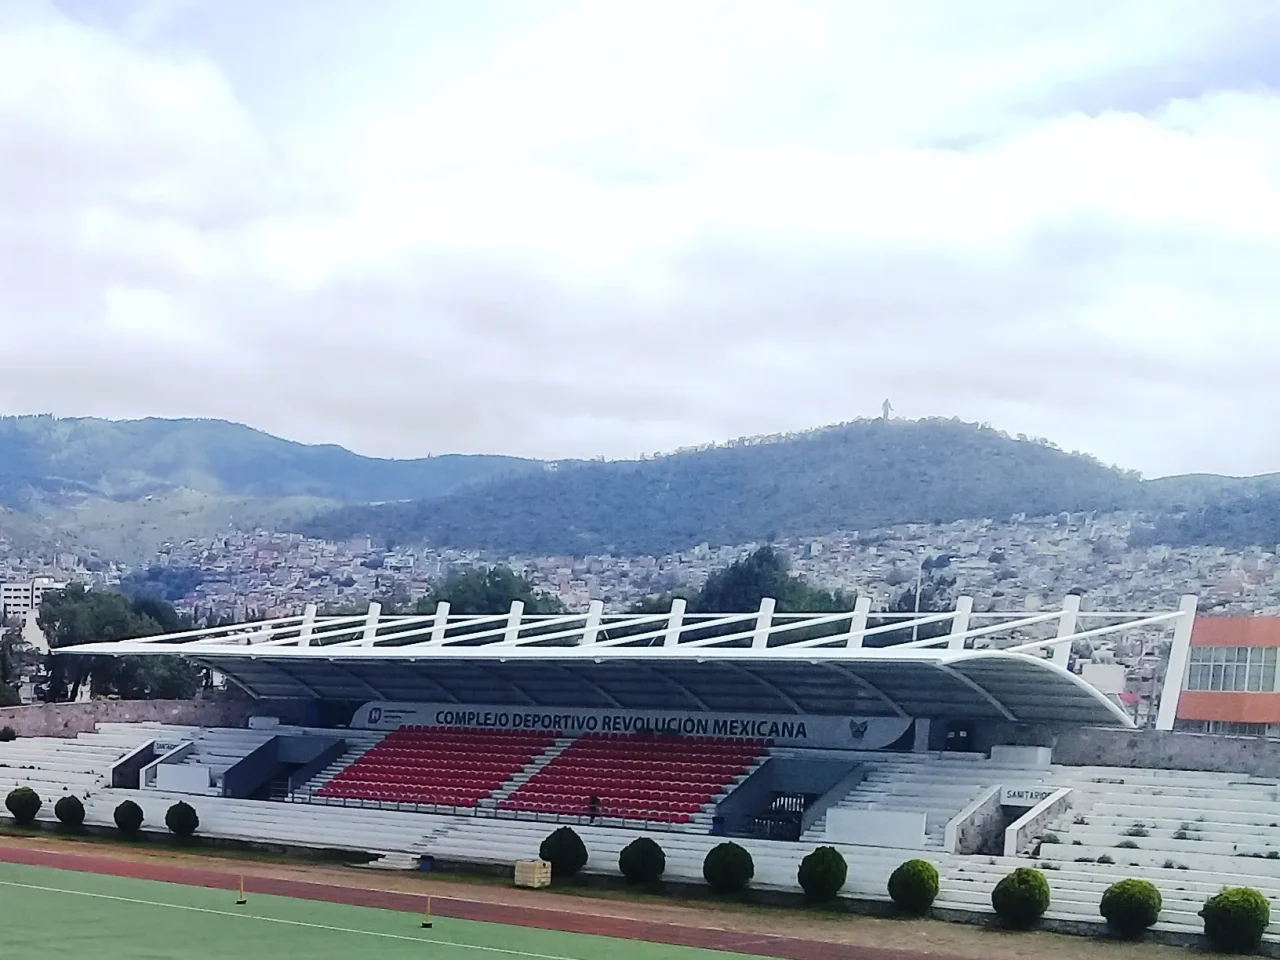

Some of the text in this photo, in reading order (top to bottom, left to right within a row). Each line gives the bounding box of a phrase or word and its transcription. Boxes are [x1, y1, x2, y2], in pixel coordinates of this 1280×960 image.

[435, 711, 807, 738] COMPLEJO DEPORTIVO REVOLUCIÓN MEXICANA
